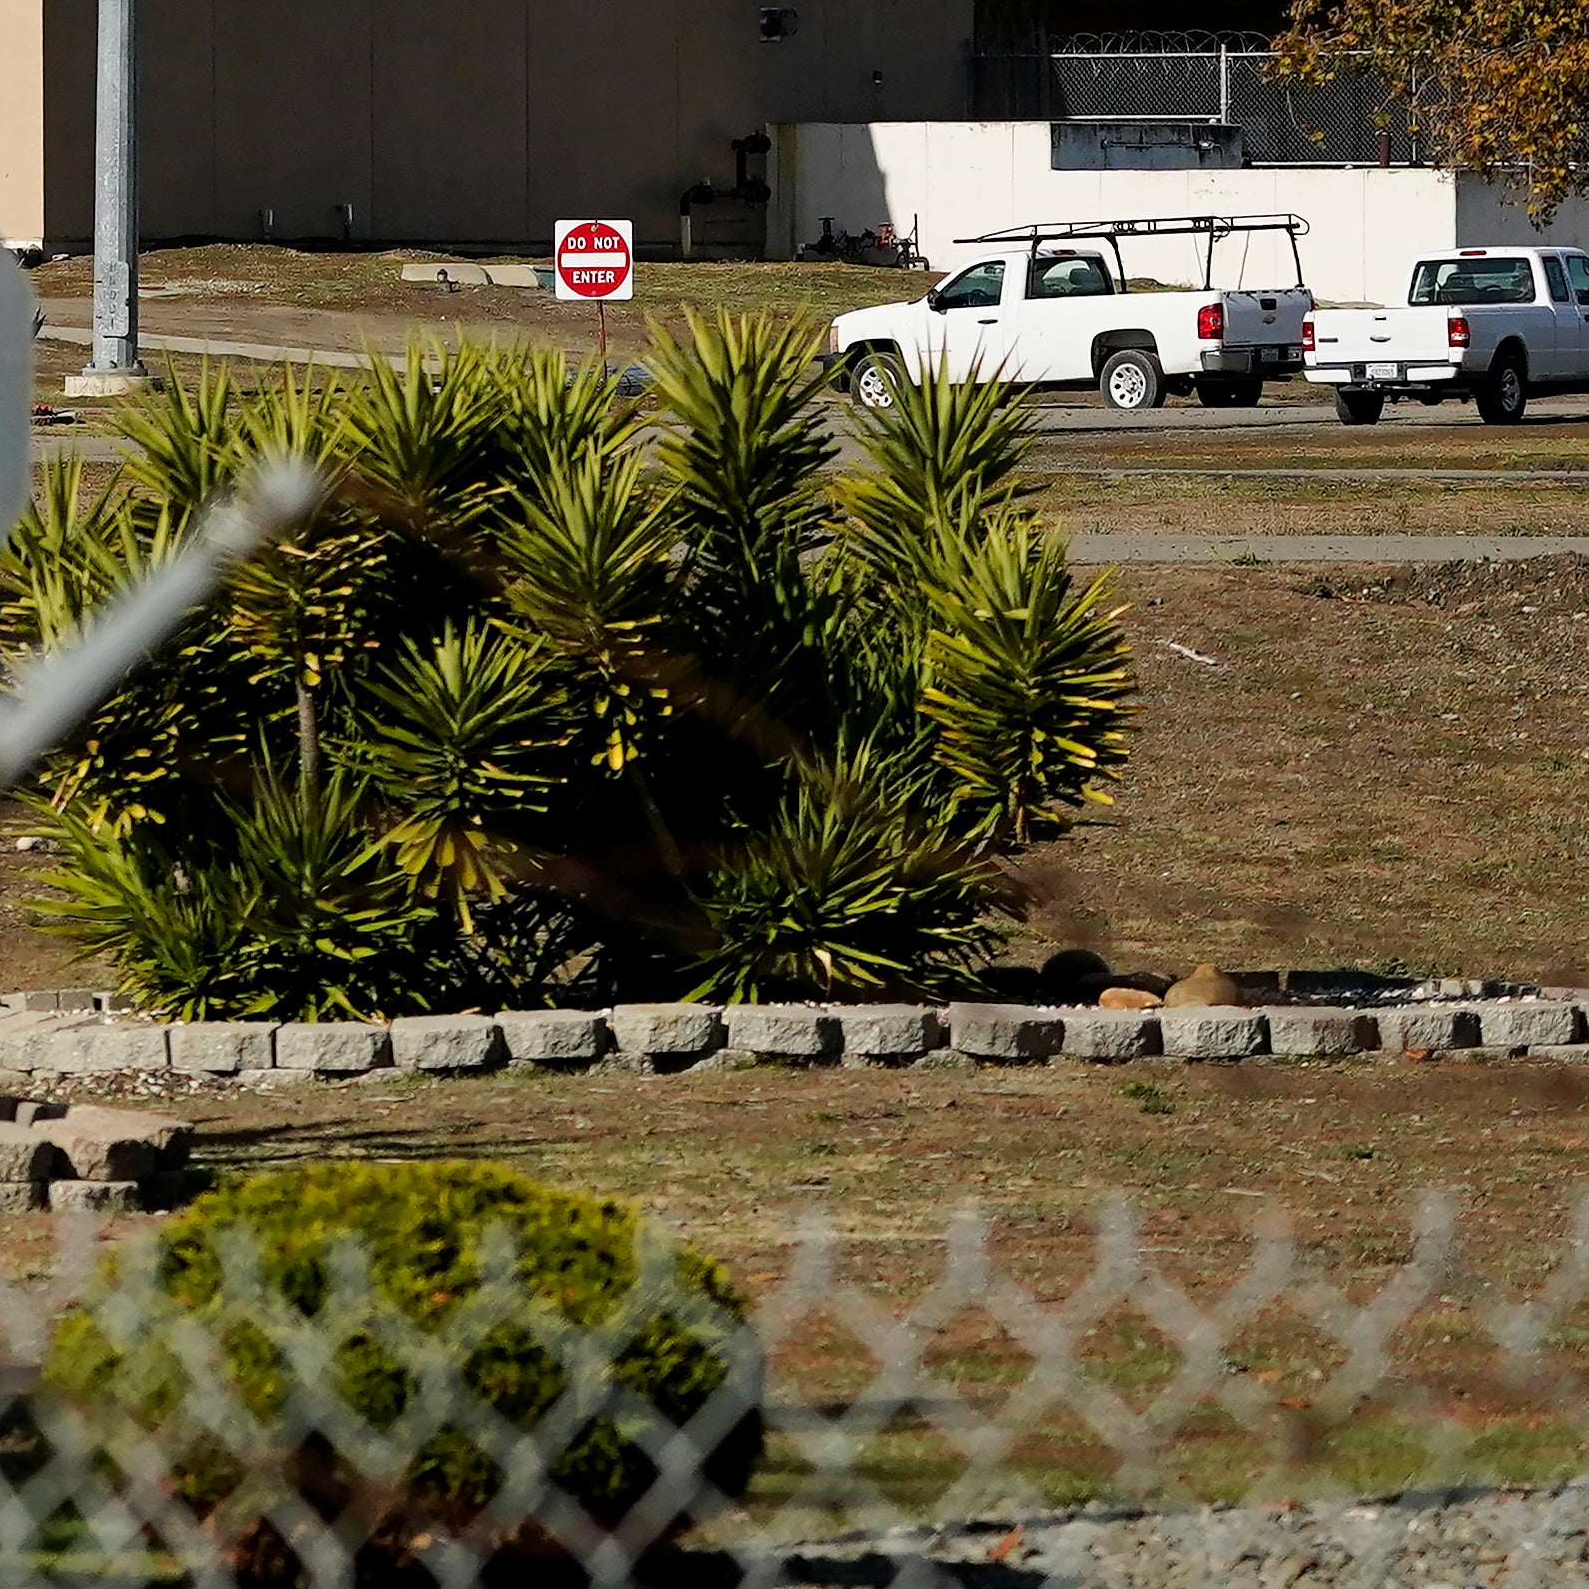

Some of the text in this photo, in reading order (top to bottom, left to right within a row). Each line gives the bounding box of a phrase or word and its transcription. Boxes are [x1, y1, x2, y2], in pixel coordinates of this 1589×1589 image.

[567, 237, 620, 250] DO NOT
[572, 270, 615, 284] ENTER
